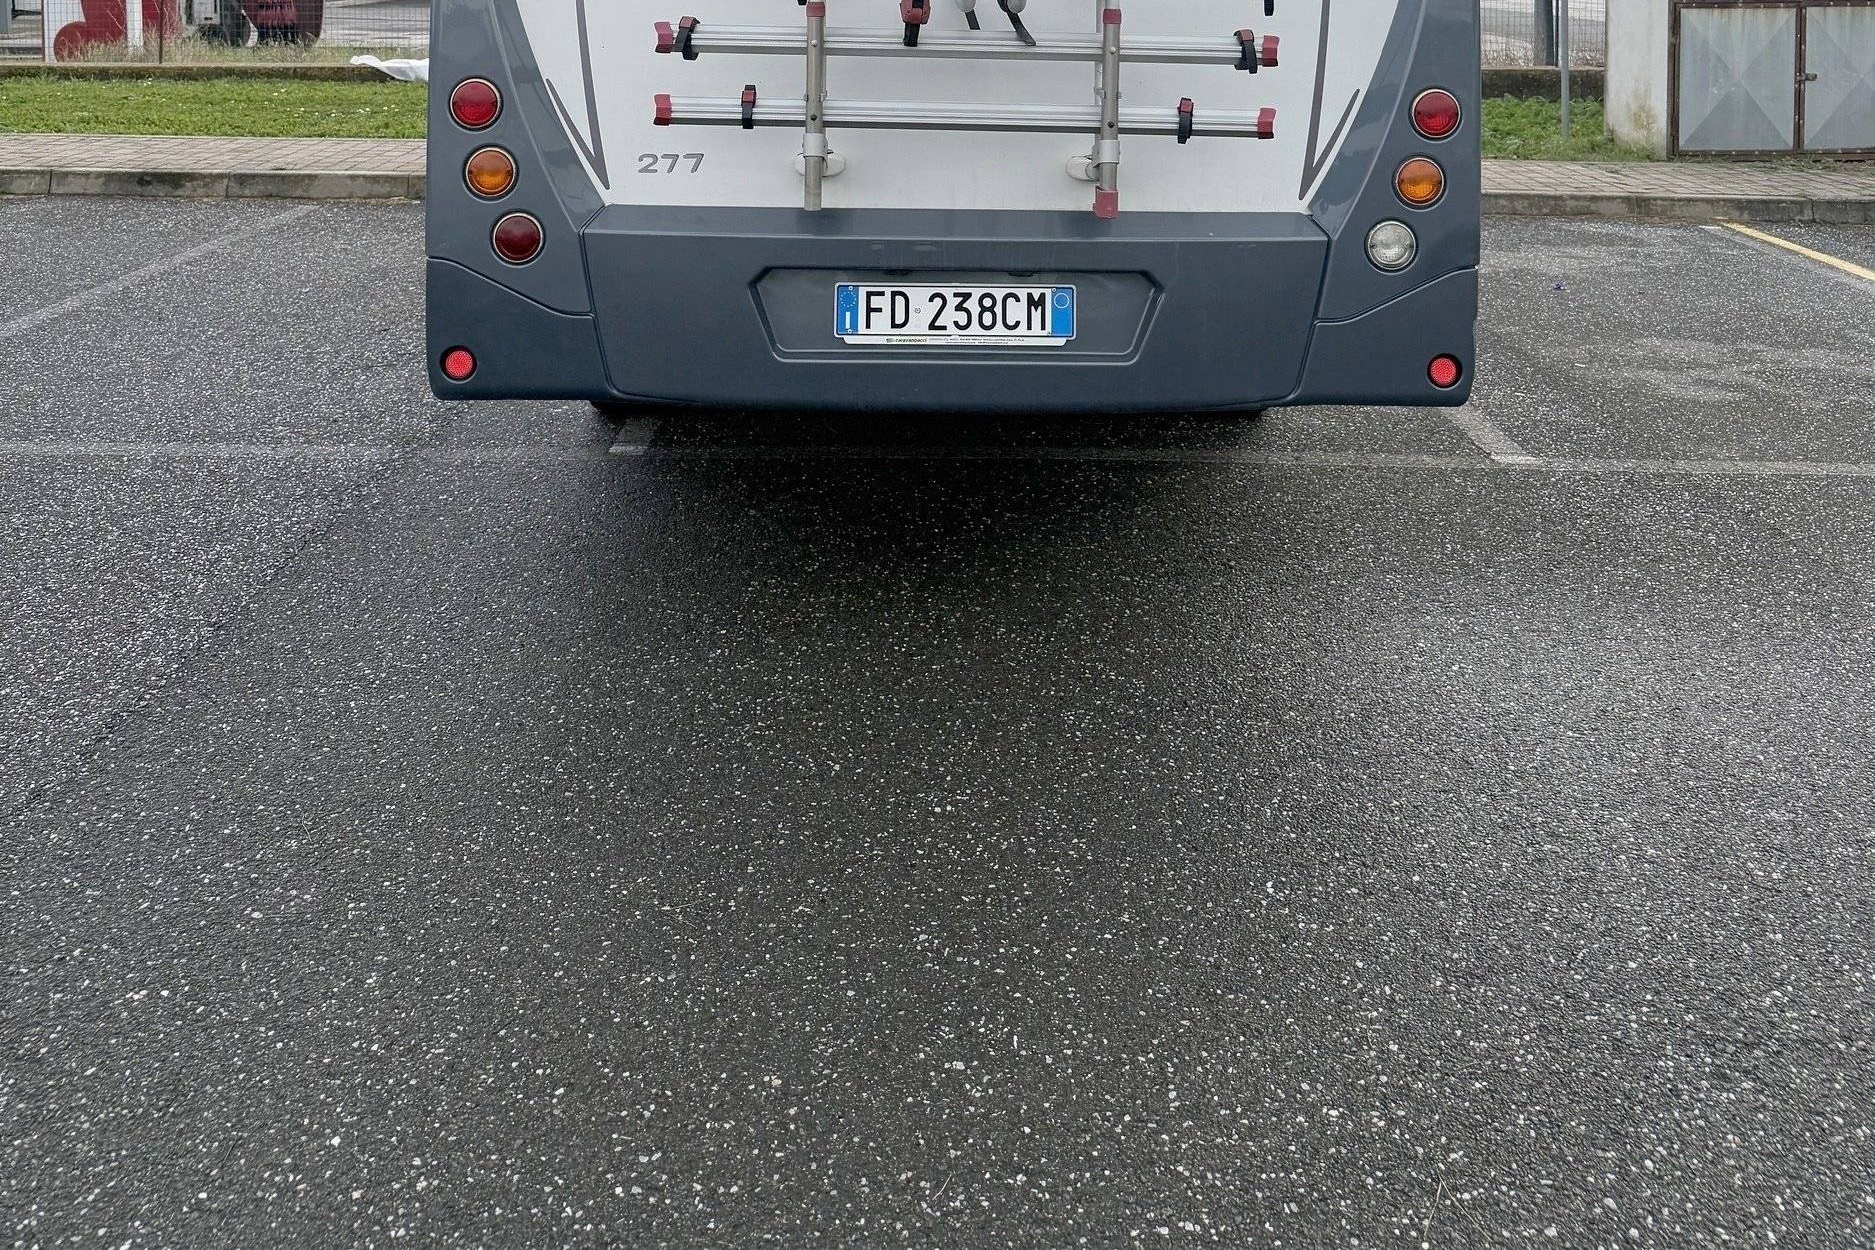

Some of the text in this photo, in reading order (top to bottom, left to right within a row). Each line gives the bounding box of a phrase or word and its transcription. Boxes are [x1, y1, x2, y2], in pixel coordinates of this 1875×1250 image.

[638, 153, 705, 173] 277
[865, 291, 1047, 332] FD 238CM
